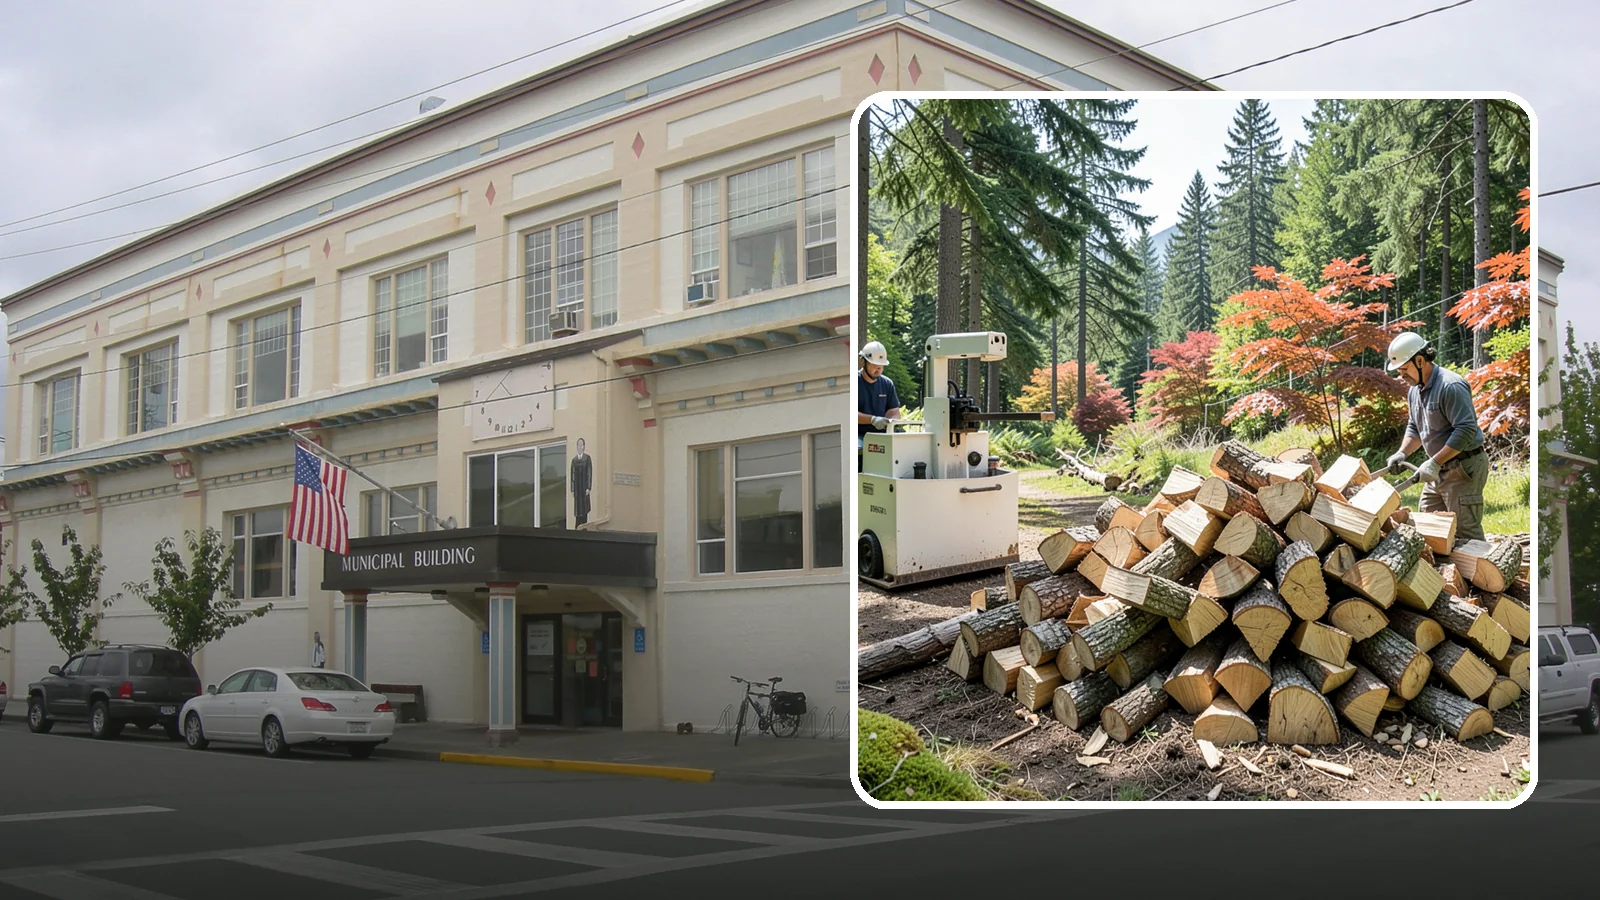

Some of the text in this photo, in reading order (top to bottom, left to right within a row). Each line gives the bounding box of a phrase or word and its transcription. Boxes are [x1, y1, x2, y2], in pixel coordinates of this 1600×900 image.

[536, 402, 540, 410] 4
[480, 406, 484, 415] 8
[488, 418, 492, 426] 9
[528, 414, 532, 422] 3
[494, 424, 500, 432] 10
[520, 420, 526, 428] 2
[342, 546, 475, 572] MUNICIPAL BUILDING
